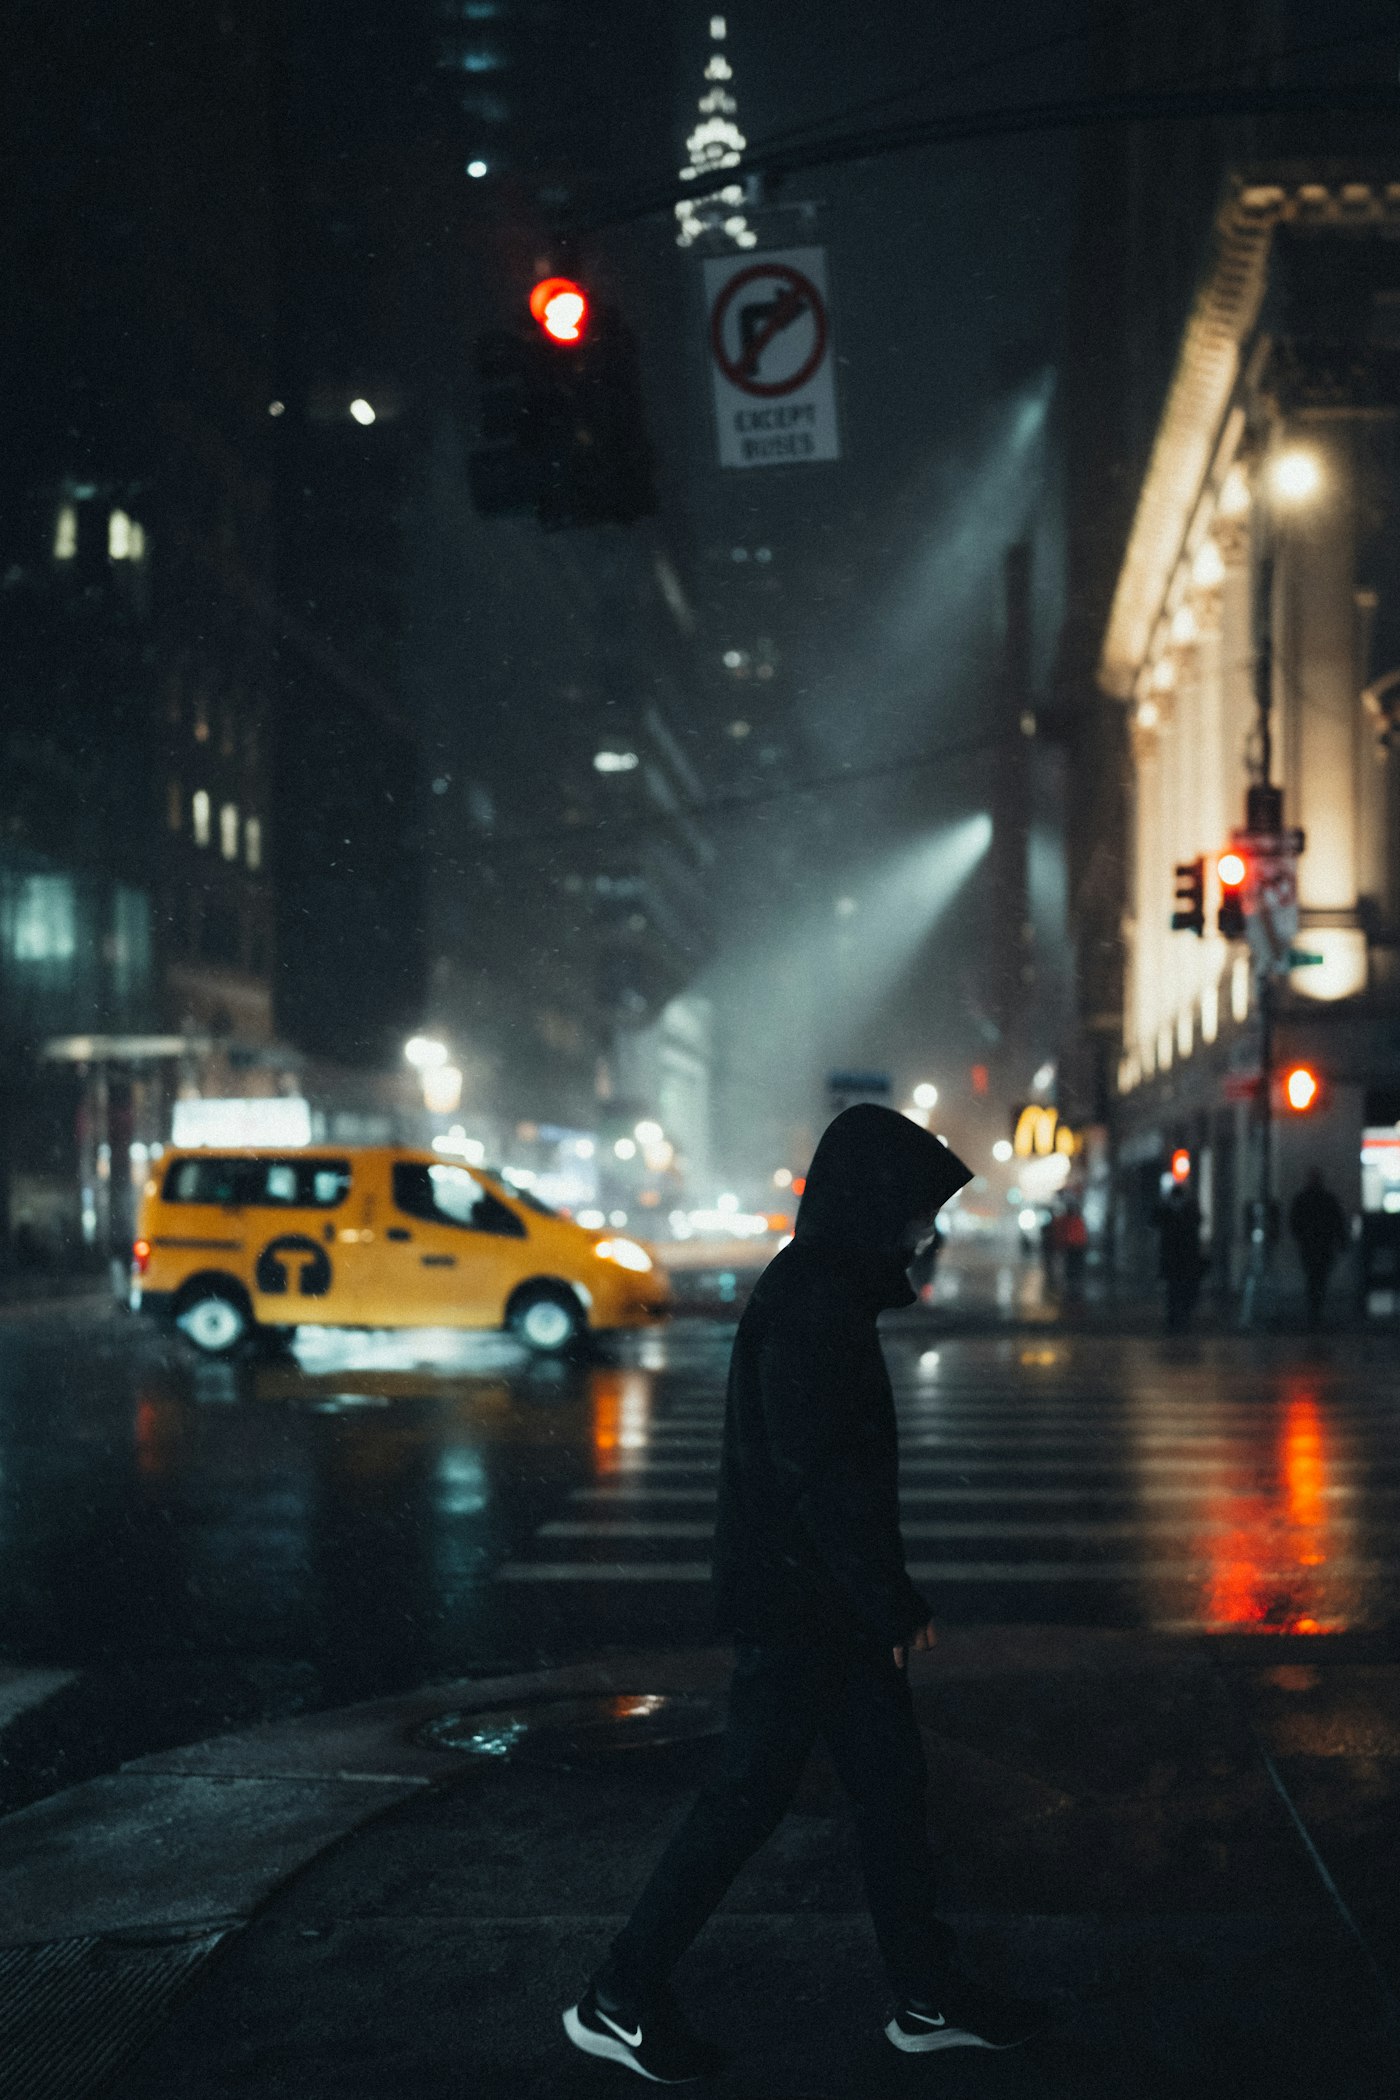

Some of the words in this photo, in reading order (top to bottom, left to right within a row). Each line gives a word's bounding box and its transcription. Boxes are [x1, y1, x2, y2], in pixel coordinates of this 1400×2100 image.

[735, 405, 815, 432] EXCEPT
[743, 434, 815, 459] BUSES
[274, 1249, 315, 1295] T
